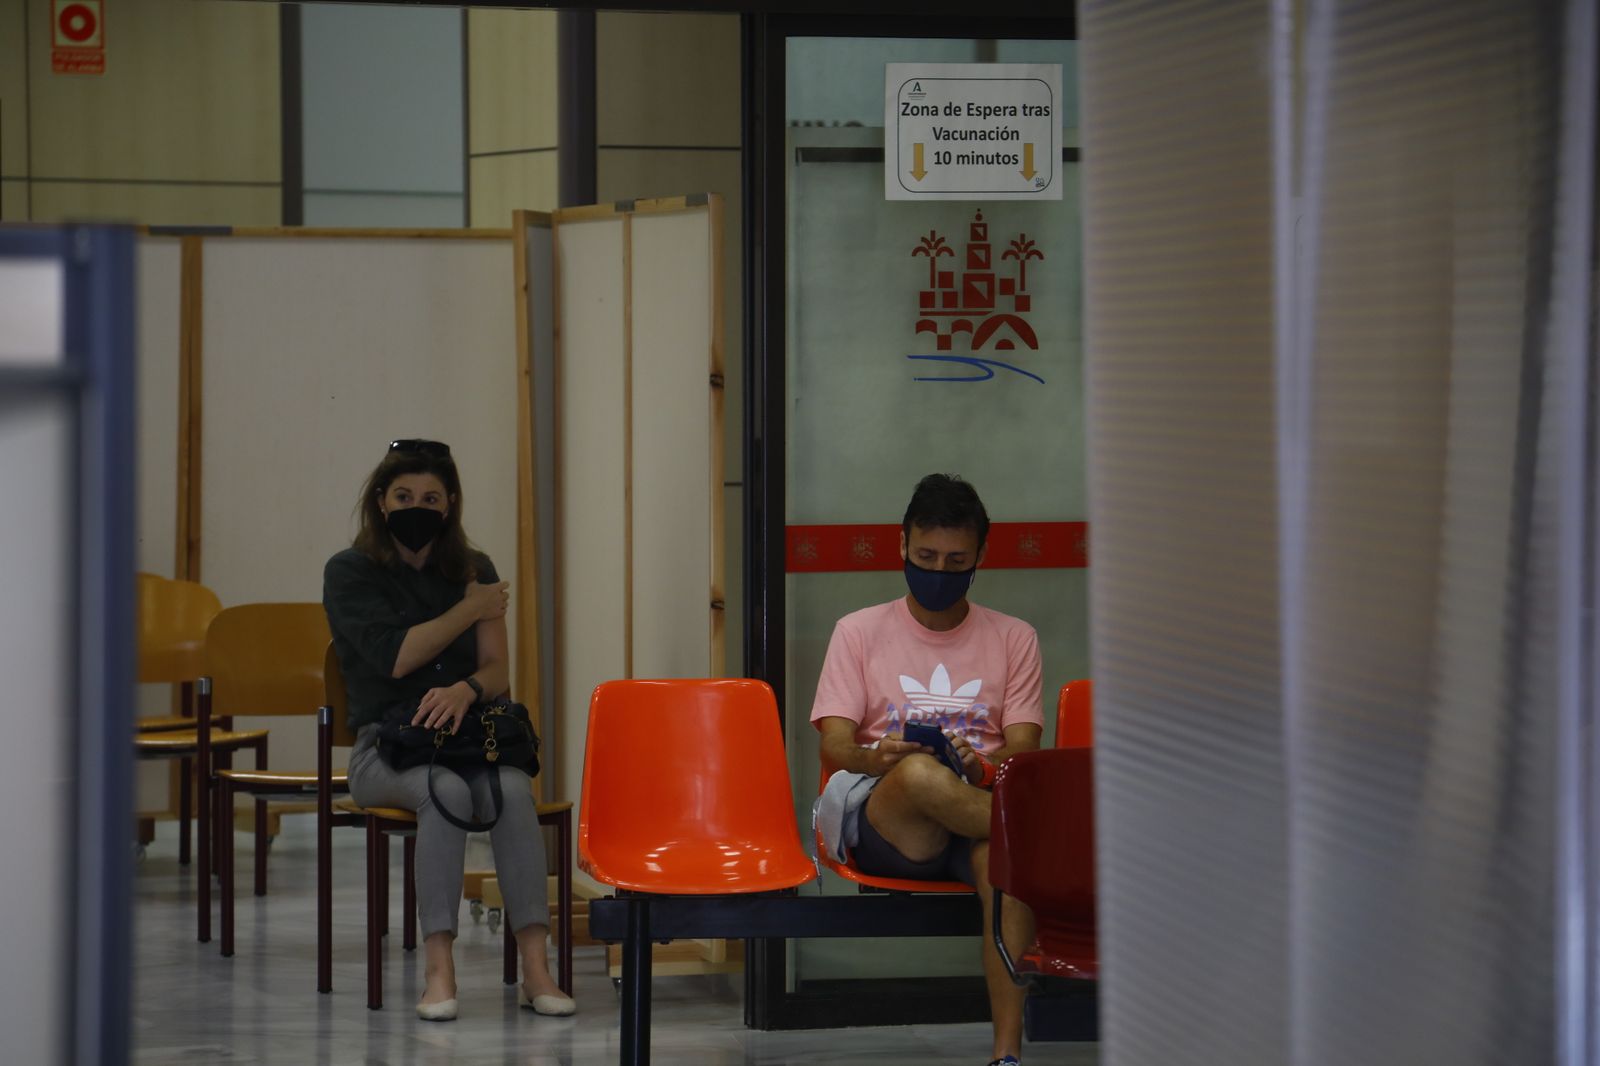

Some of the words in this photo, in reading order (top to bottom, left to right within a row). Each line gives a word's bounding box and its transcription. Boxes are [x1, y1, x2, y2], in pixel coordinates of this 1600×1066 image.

[901, 102, 939, 117] Zona
[943, 101, 962, 117] de
[967, 102, 1017, 120] Espera
[1022, 103, 1051, 117] tras
[932, 126, 1020, 141] Vacunación
[934, 151, 952, 165] 10
[956, 150, 1019, 165] minutos
